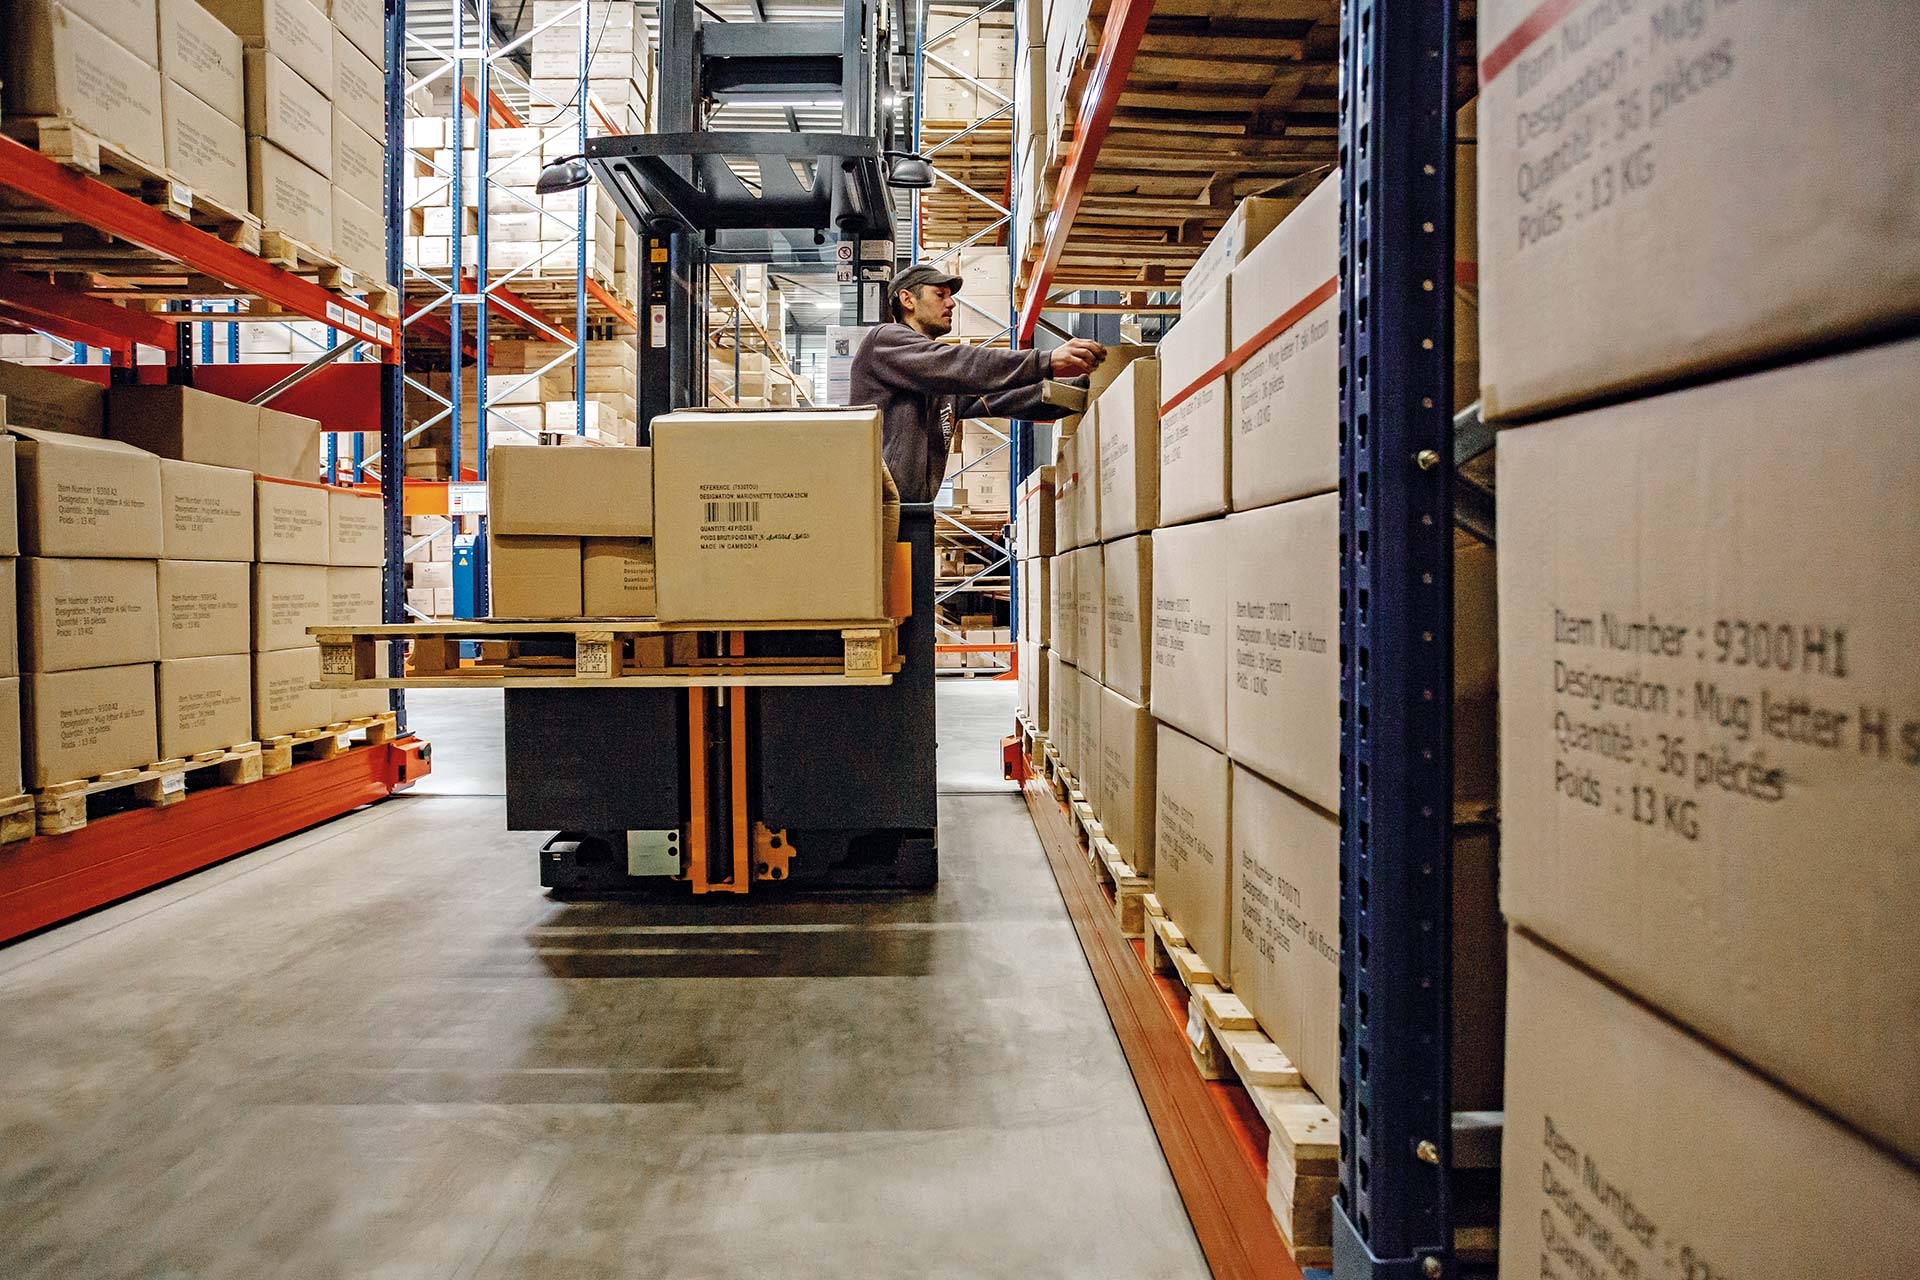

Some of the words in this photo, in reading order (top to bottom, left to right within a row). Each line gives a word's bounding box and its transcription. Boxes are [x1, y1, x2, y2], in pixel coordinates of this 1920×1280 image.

[1515, 45, 1555, 98] Item
[1516, 48, 1625, 149] Designation
[1615, 87, 1643, 140] 36
[1518, 201, 1563, 251] Poids
[1592, 165, 1615, 211] 13
[1622, 142, 1655, 193] KG
[1555, 608, 1594, 645] Item
[1600, 612, 1689, 657] Number
[1554, 659, 1668, 710] Designation
[1695, 681, 1750, 742] Mug
[1762, 689, 1848, 749] letter
[1858, 704, 1889, 760] H
[1554, 711, 1633, 764] Quantité
[1658, 733, 1687, 778] 36
[1694, 744, 1785, 802] pièces
[1555, 760, 1601, 806] Poids
[1632, 784, 1656, 825] 13
[1664, 793, 1699, 841] KG
[1544, 1115, 1579, 1176] Item
[1583, 1154, 1656, 1248] Number
